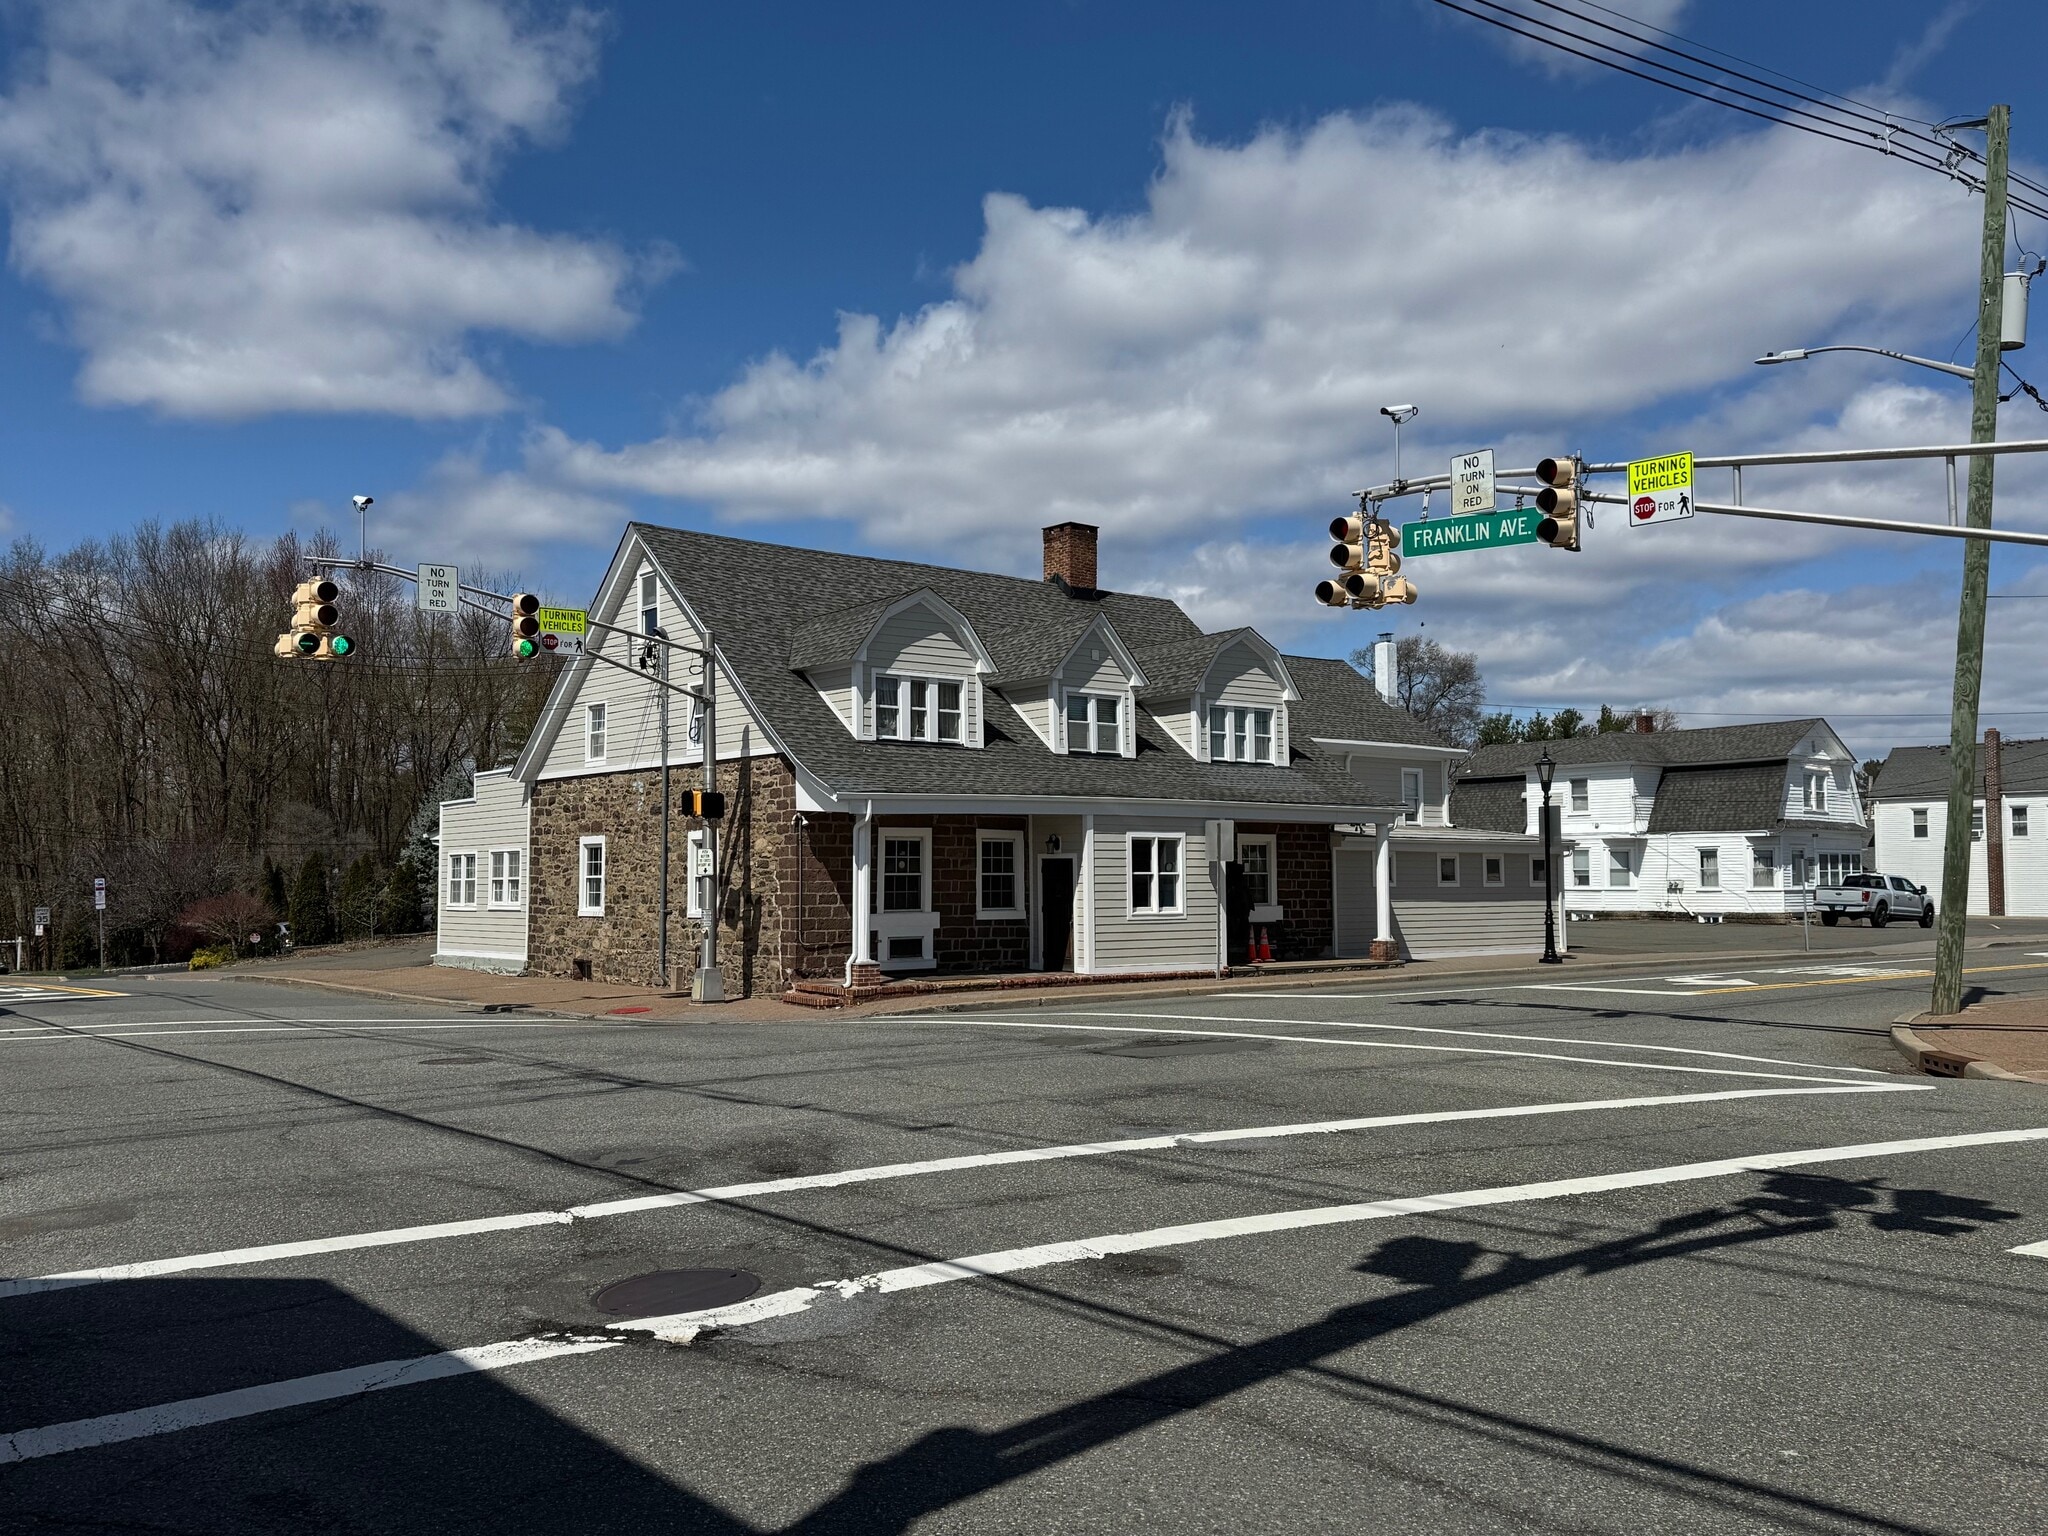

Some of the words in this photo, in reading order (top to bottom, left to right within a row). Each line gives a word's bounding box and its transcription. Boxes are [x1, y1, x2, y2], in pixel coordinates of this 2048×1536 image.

[1464, 456, 1479, 470] NO
[1635, 457, 1686, 477] TURNING
[1460, 470, 1485, 483] TURN
[1634, 471, 1687, 491] VEHICLES
[1466, 484, 1479, 494] ON
[1464, 496, 1482, 508] RED
[1635, 502, 1655, 514] STOP
[1658, 501, 1675, 512] FOR
[1413, 521, 1490, 548] FRANKLIN
[1499, 517, 1532, 538] AVE.
[430, 568, 445, 578] NO
[426, 579, 450, 588] TURN
[432, 590, 444, 598] ON
[544, 610, 582, 621] TURNING
[543, 621, 583, 632] VEHICLES
[560, 640, 573, 648] FOR
